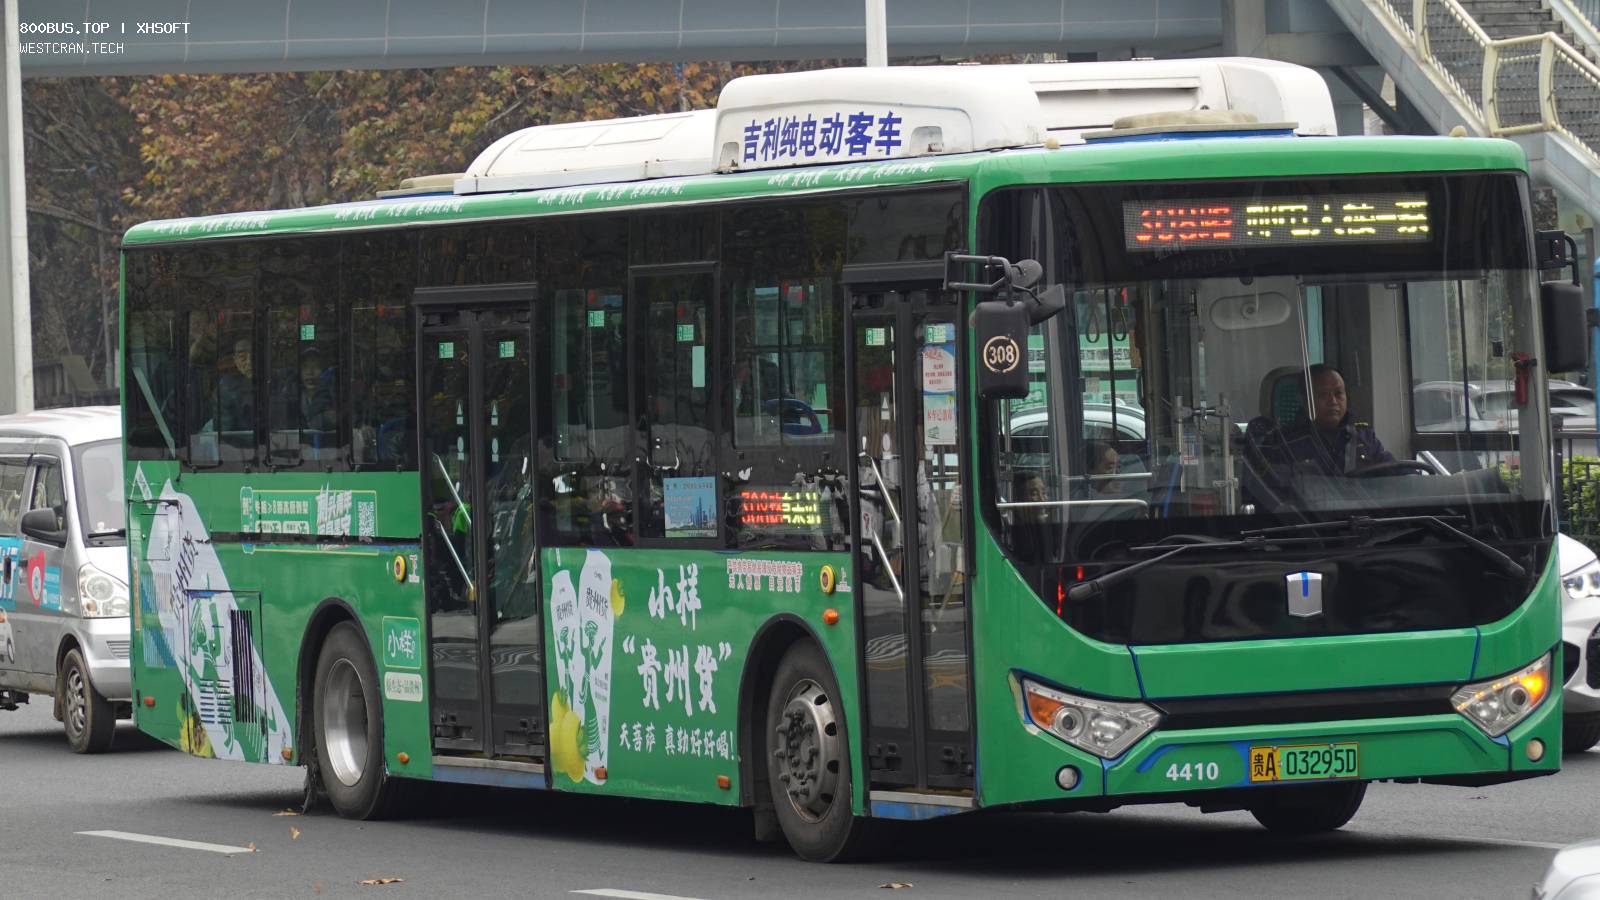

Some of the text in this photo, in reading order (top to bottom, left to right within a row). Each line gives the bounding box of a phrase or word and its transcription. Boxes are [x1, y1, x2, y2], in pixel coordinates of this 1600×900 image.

[743, 111, 902, 162] 吉利纯电动客车
[988, 345, 1015, 364] 308
[648, 562, 702, 631] 小样
[619, 721, 656, 752] 天菩萨
[1166, 762, 1219, 780] 4410
[1253, 748, 1357, 777] 贵A 03295D
